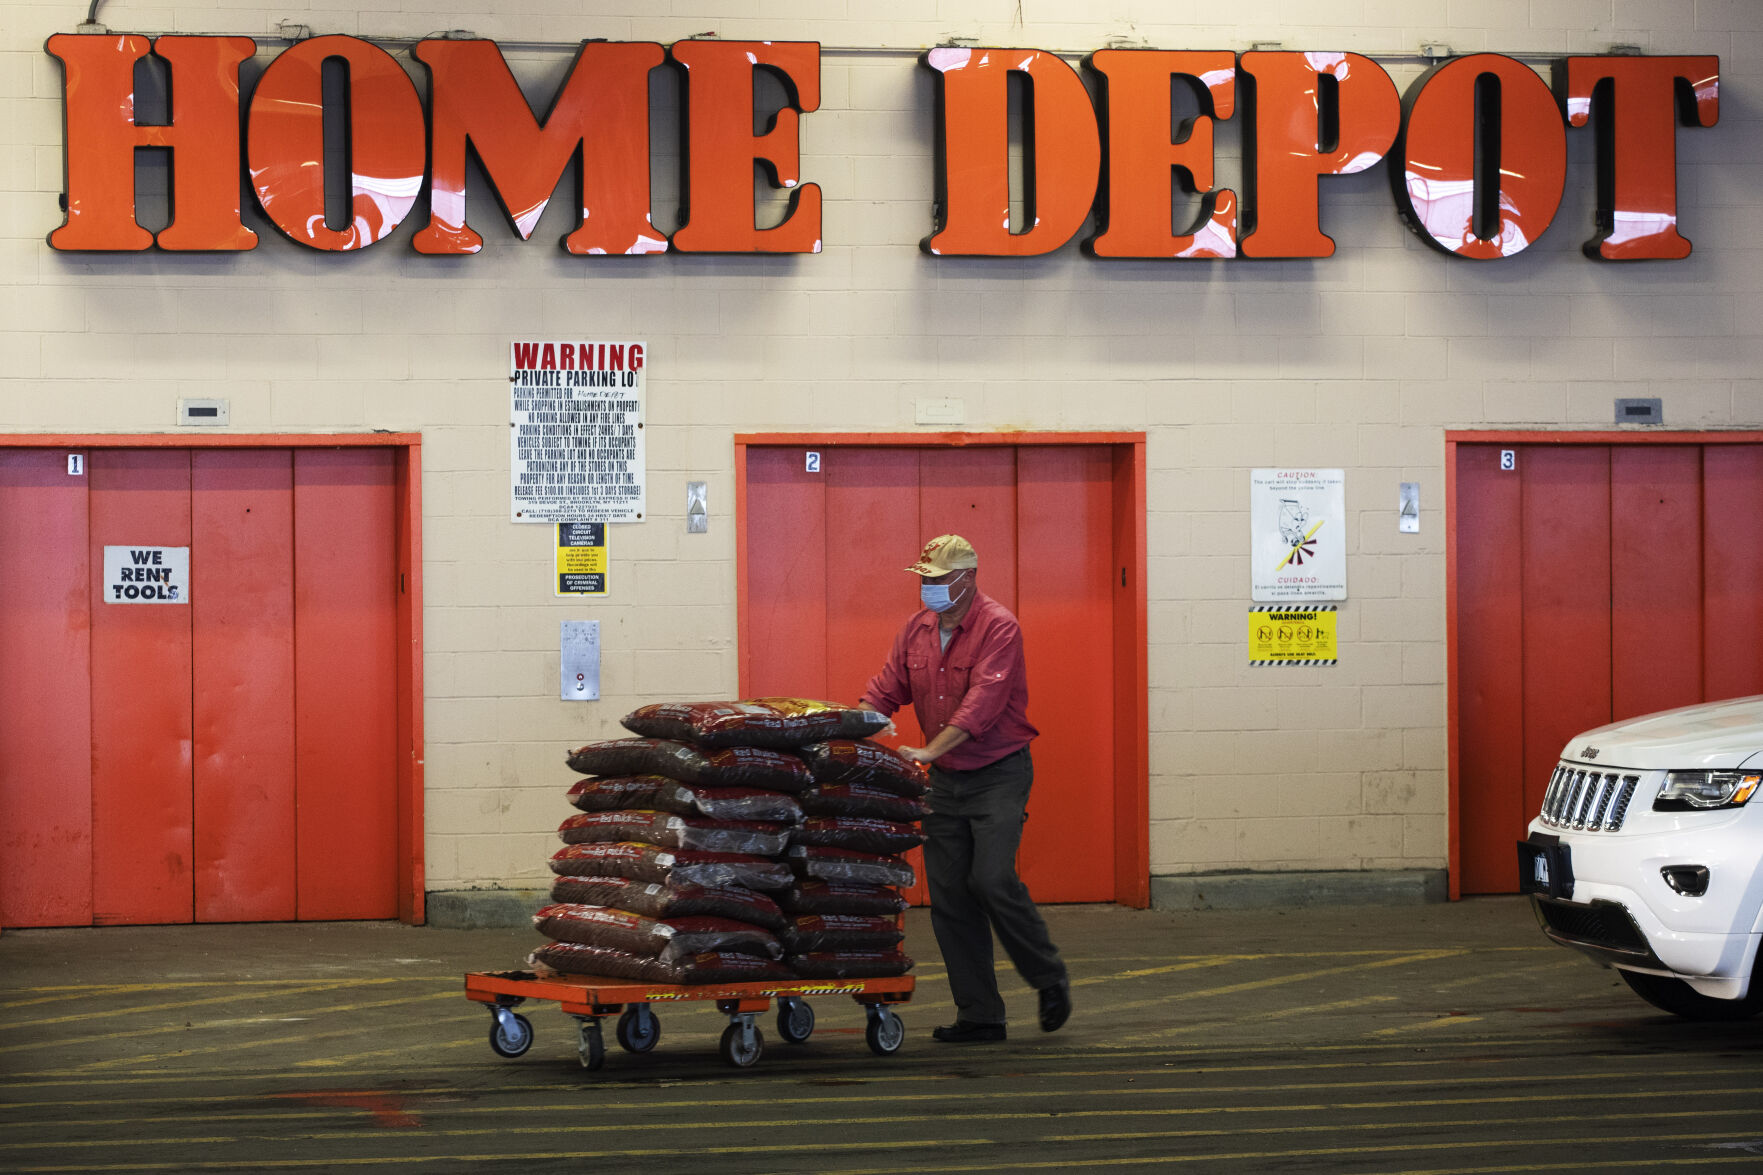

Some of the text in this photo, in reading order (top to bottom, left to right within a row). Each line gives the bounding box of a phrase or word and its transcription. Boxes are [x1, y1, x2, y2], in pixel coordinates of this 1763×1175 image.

[46, 33, 1720, 262] HOME DEPOT
[514, 343, 644, 372] WARNING
[514, 370, 561, 387] PRIVATE
[566, 370, 616, 387] PARKING
[514, 388, 573, 399] PARKING PERMITTED FOR
[515, 400, 529, 412] WHILE
[532, 400, 556, 412] SHOPPING
[558, 400, 563, 412] IN
[564, 400, 606, 412] ESTABLISHMENTS
[608, 400, 614, 412] ON
[528, 412, 625, 423] NO PARKING ALLOWED IN ANY FIRE LINES
[520, 425, 540, 436] PARKING
[543, 425, 571, 436] CONDITIONS
[574, 425, 578, 436] IN
[580, 425, 596, 436] EFFECT
[622, 425, 634, 436] DAYS
[518, 437, 540, 448] VEHICLES
[542, 437, 562, 448] SUBJECT
[564, 437, 570, 448] TO
[572, 437, 591, 448] TOWING
[593, 437, 598, 448] IF
[608, 437, 636, 448] OCCUPANTS
[518, 449, 635, 460] LEAVE THE PARKING LOT AND NO OCCUPANTS ARE
[1503, 452, 1512, 468] 3
[72, 456, 79, 473] 1
[527, 461, 627, 472] PATRONIZING ANY OF THE STORES ON THIS
[808, 454, 818, 470] 2
[520, 473, 633, 484] PROPERTY FOR ANY REASON OR LENGTH OF TIME
[514, 486, 533, 495] RELEASE
[600, 486, 603, 495] 3
[605, 486, 616, 495] DAYS
[130, 551, 162, 565] WE
[121, 568, 172, 582] RENT
[112, 585, 178, 600] TOOLS
